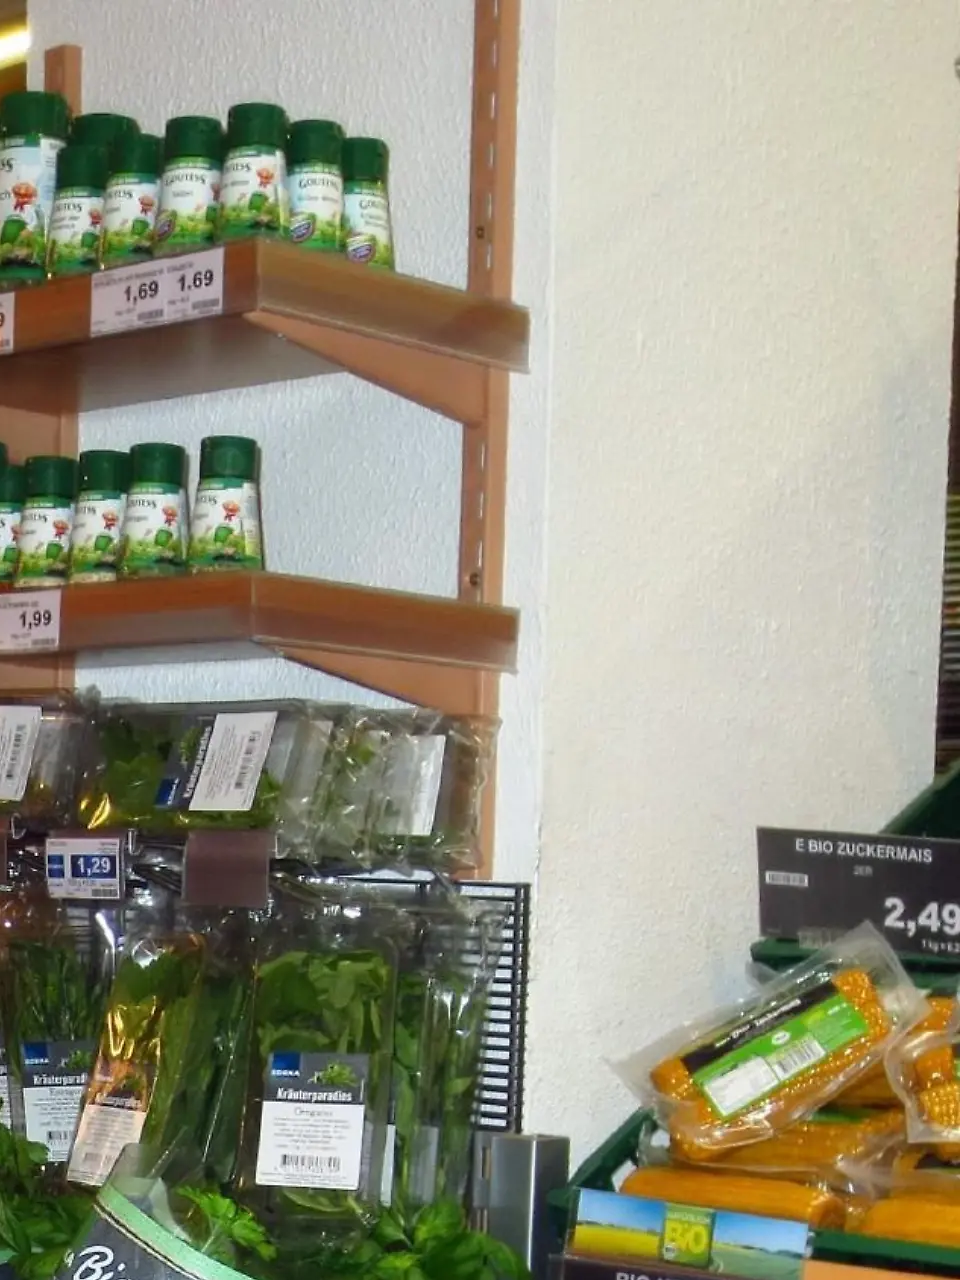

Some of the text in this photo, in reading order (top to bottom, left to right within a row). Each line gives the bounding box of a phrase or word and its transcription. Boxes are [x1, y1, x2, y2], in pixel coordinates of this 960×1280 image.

[124, 280, 159, 305] 1,69
[19, 609, 52, 631] 1,99
[795, 838, 933, 863] E BIO ZUCKERMAIS
[76, 856, 111, 877] 1,29
[883, 896, 960, 939] 2,49
[277, 1087, 353, 1103] Kräuterparadies
